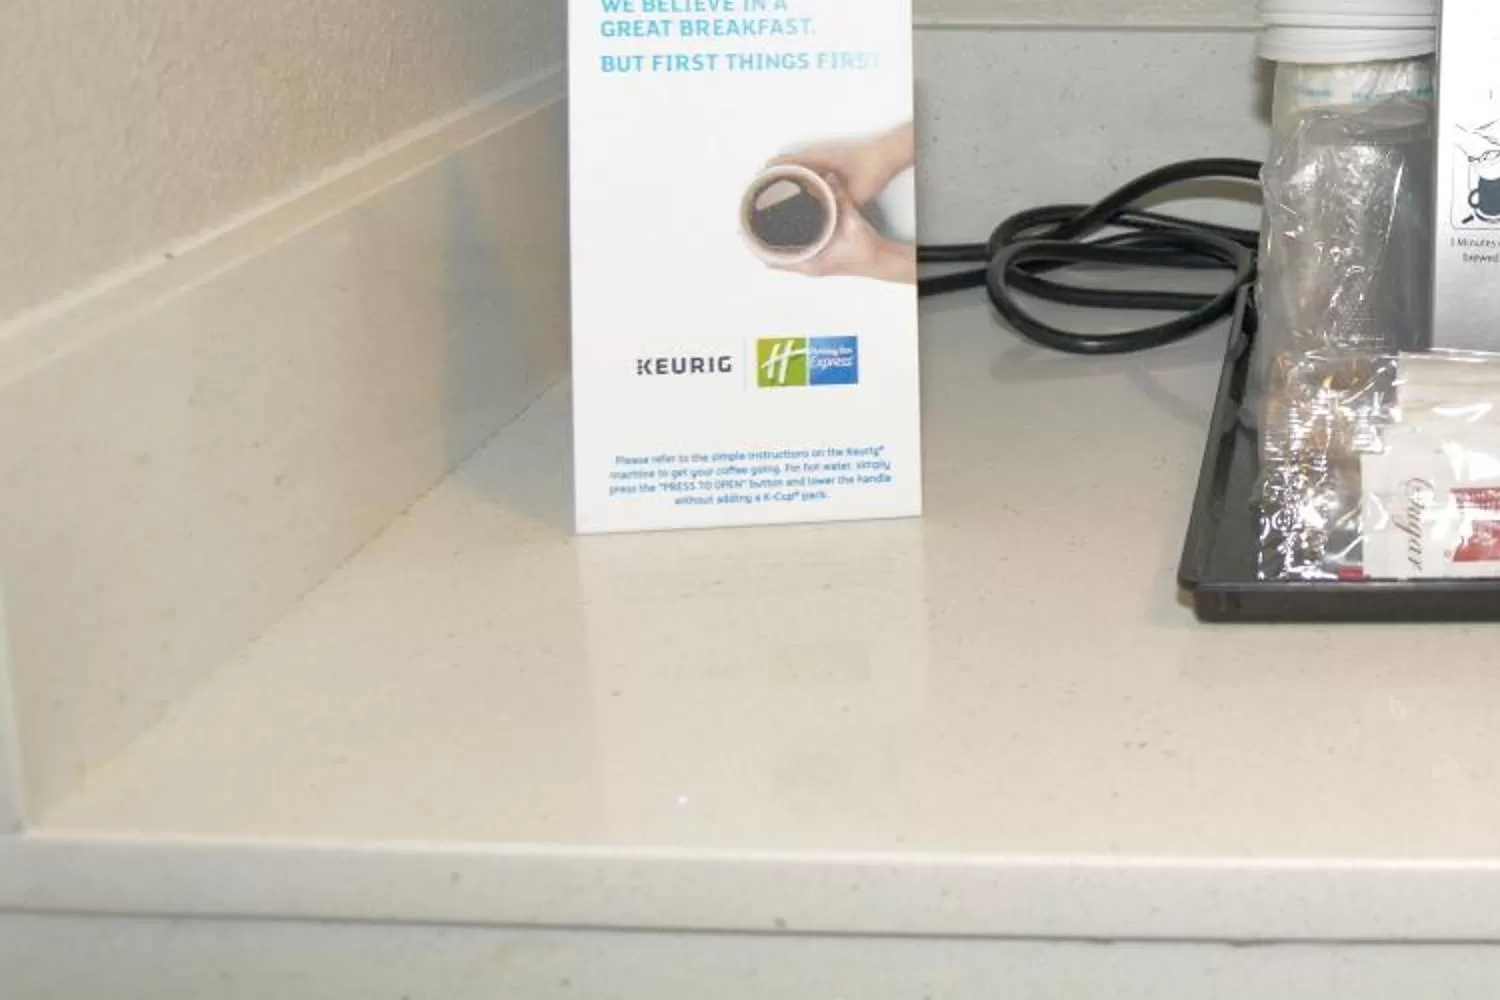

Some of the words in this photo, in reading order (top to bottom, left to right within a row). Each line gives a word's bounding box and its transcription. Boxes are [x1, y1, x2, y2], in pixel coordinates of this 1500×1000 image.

[600, 20, 672, 38] GREAT
[600, 55, 645, 73] BUT
[652, 54, 718, 72] FIRST
[726, 53, 810, 71] THINGS
[637, 355, 733, 375] KEURIG
[691, 453, 708, 462] the
[712, 451, 746, 463] simple
[747, 449, 809, 460] instructions
[827, 446, 844, 457] the
[716, 465, 749, 475] coffee
[785, 476, 805, 486] and
